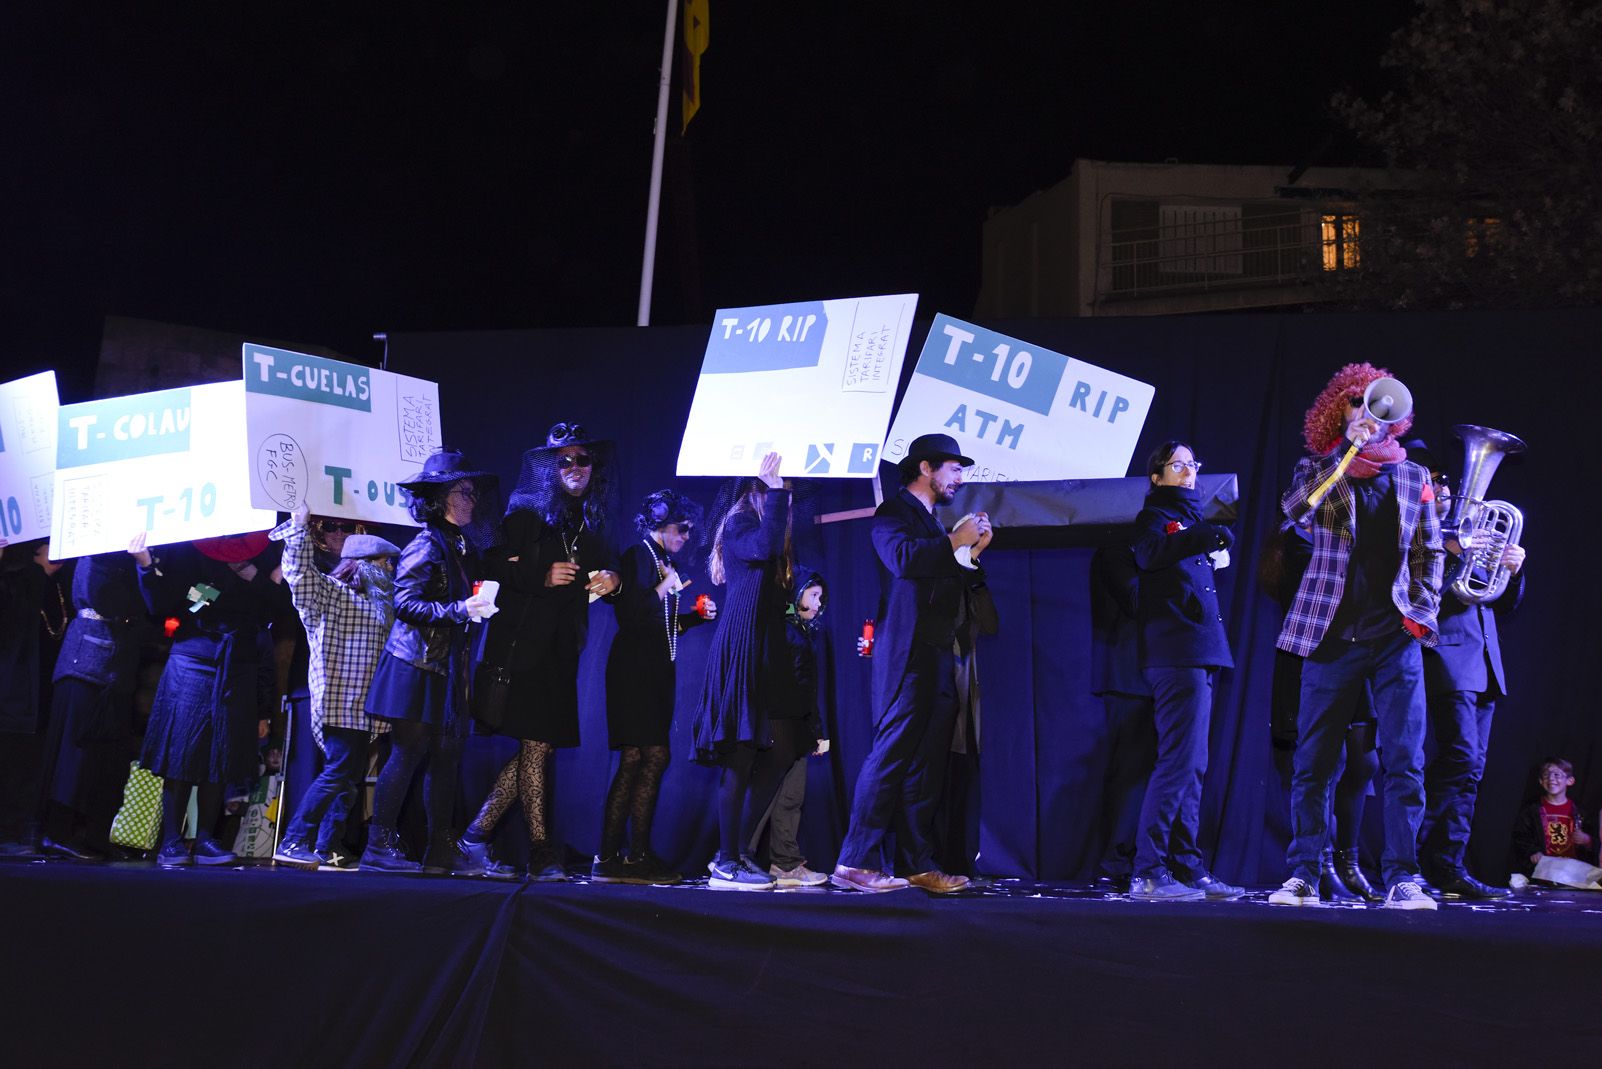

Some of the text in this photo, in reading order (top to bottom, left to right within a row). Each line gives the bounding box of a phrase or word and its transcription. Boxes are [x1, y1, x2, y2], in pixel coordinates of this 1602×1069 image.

[721, 315, 817, 343] T-10 RIP
[872, 324, 891, 381] INTEGRAT
[254, 353, 369, 400] T-CUELAS
[846, 331, 866, 386] SISTEMA
[860, 331, 878, 384] TARIFARI
[943, 324, 1130, 424] T-10 RIP
[69, 407, 191, 450] T-COLAU
[402, 396, 418, 457] SISTEMA
[422, 393, 436, 455] NTEGRAT
[944, 404, 1025, 450] ATM
[266, 449, 278, 481] FGC
[280, 442, 297, 509] BUS-METRO
[136, 482, 217, 531] T-10
